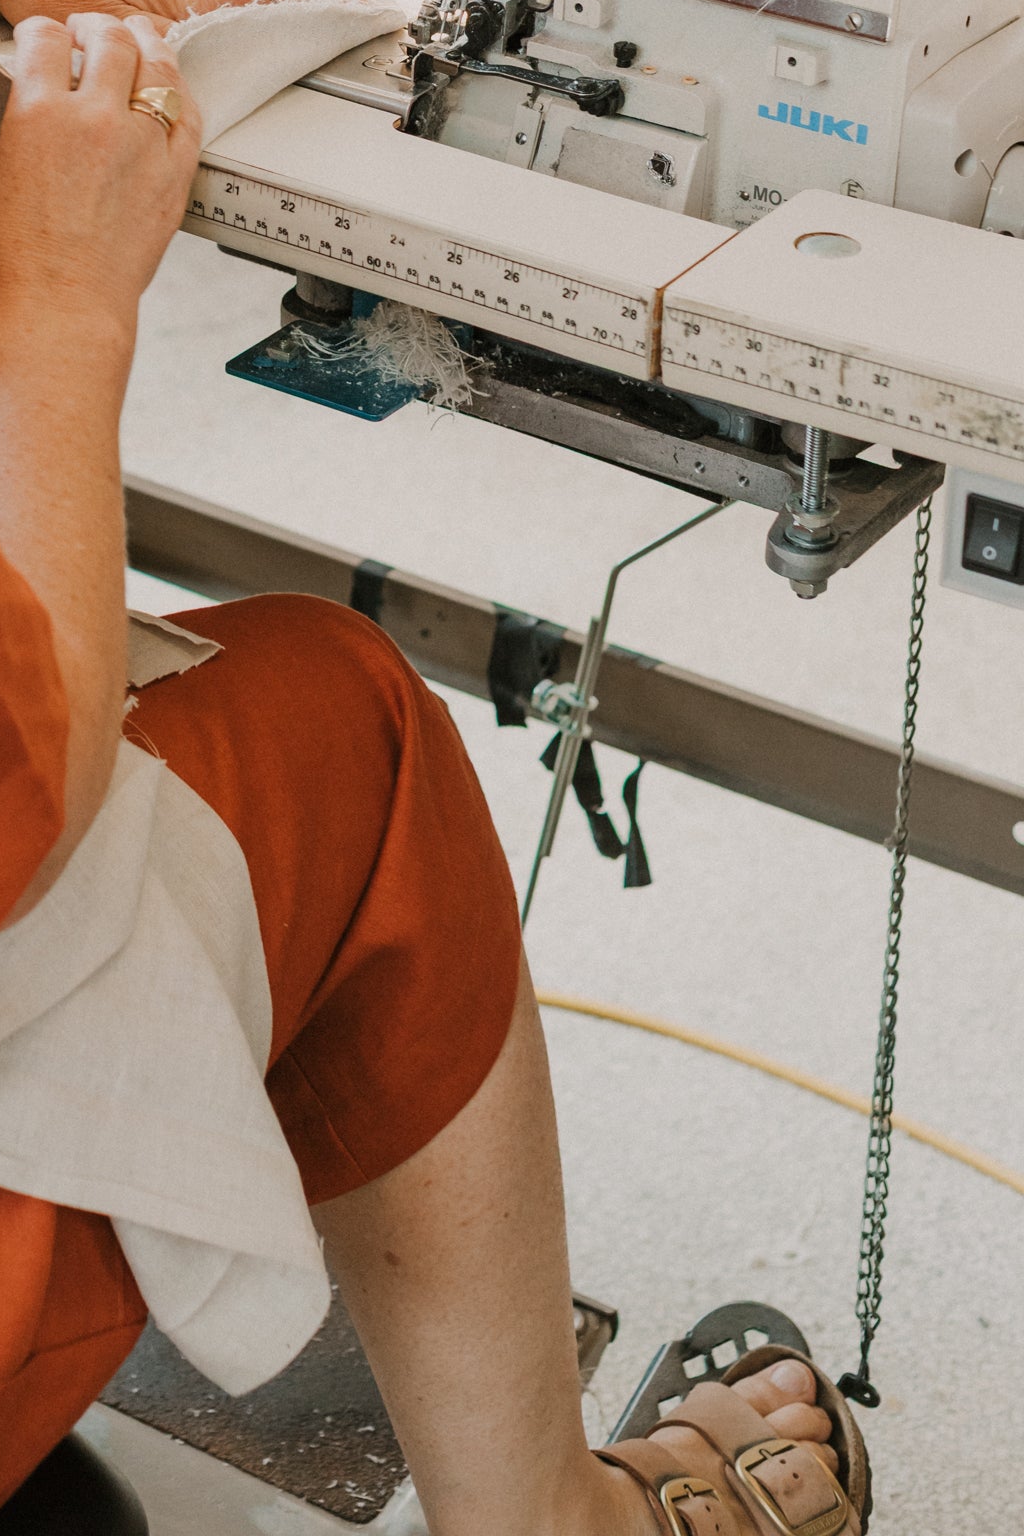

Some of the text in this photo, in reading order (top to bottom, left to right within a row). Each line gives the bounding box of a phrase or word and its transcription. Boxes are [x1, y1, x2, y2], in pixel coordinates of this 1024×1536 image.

[757, 101, 869, 145] JUKI
[214, 206, 225, 216] 53
[235, 213, 246, 223] 54
[256, 220, 267, 229] 55
[277, 226, 288, 236] 56
[299, 234, 310, 243] 57
[320, 240, 331, 250] 58
[341, 247, 353, 256] 59
[366, 255, 382, 268] 60
[385, 260, 396, 270] 61
[407, 268, 418, 277] 62
[592, 326, 608, 339] 70
[224, 182, 638, 320] 21 22 23 24 25 26 27 28
[745, 338, 763, 352] 30
[873, 373, 890, 388] 32
